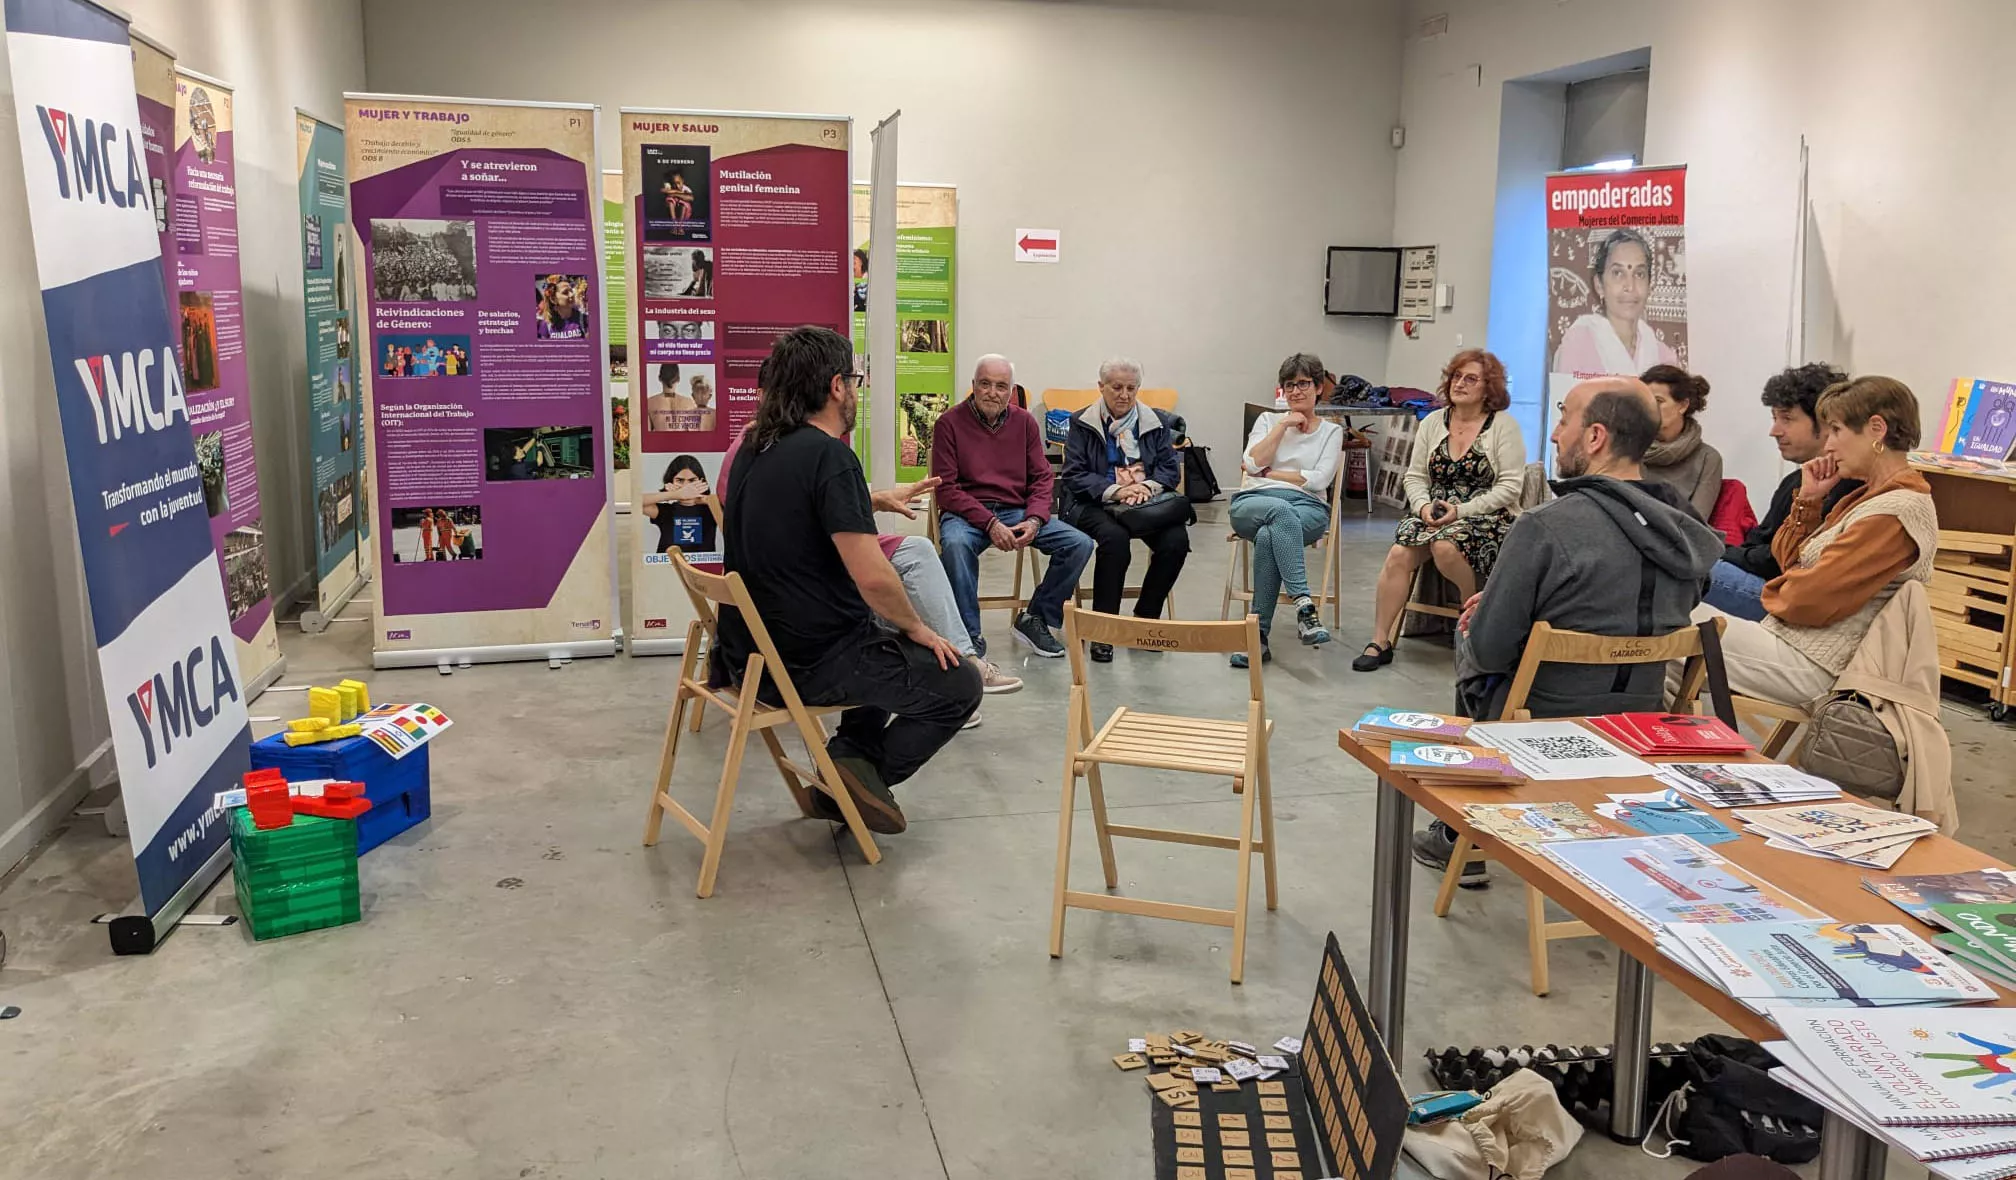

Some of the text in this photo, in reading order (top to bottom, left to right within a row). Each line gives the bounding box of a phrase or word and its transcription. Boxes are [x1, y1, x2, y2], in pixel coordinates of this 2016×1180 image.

[359, 109, 470, 124] MUJER Y TRABAJO
[570, 118, 581, 128] P1
[633, 122, 719, 134] MUJER Y SALUD
[823, 129, 836, 138] P3
[36, 105, 149, 210] YMCA
[461, 160, 537, 172] Y se atrevieron
[469, 172, 507, 183] soñar...
[720, 170, 772, 180] Mutilación
[720, 183, 800, 194] genital femenina
[1552, 180, 1672, 215] empoderadas
[1579, 214, 1679, 228] Mujeres del Comercio Justo
[376, 308, 464, 318] Reivindicaciones
[489, 310, 521, 319] salarios,
[654, 307, 686, 315] industria
[376, 319, 432, 329] de Género:
[478, 319, 519, 327] estrategias
[74, 346, 189, 444] YMCA
[380, 403, 404, 412] Según
[413, 402, 463, 412] Organización
[381, 411, 432, 419] Internacional
[446, 410, 474, 419] Trabajo
[381, 419, 404, 427] (OIT):
[1970, 441, 2003, 453] IGUALDAD
[102, 463, 198, 510] Transformando el mundo
[140, 489, 203, 526] con la juventud
[1137, 637, 1179, 648] MATADERO
[1609, 648, 1651, 658] MATADERO
[127, 635, 238, 769] YMCA
[1806, 1019, 1909, 1110] MANUAL DE FORMACIÓN
[1827, 1019, 1936, 1109] EL VOLUNTARIADO
[1850, 1019, 1961, 1109] EN COMERCIO JUSTO
